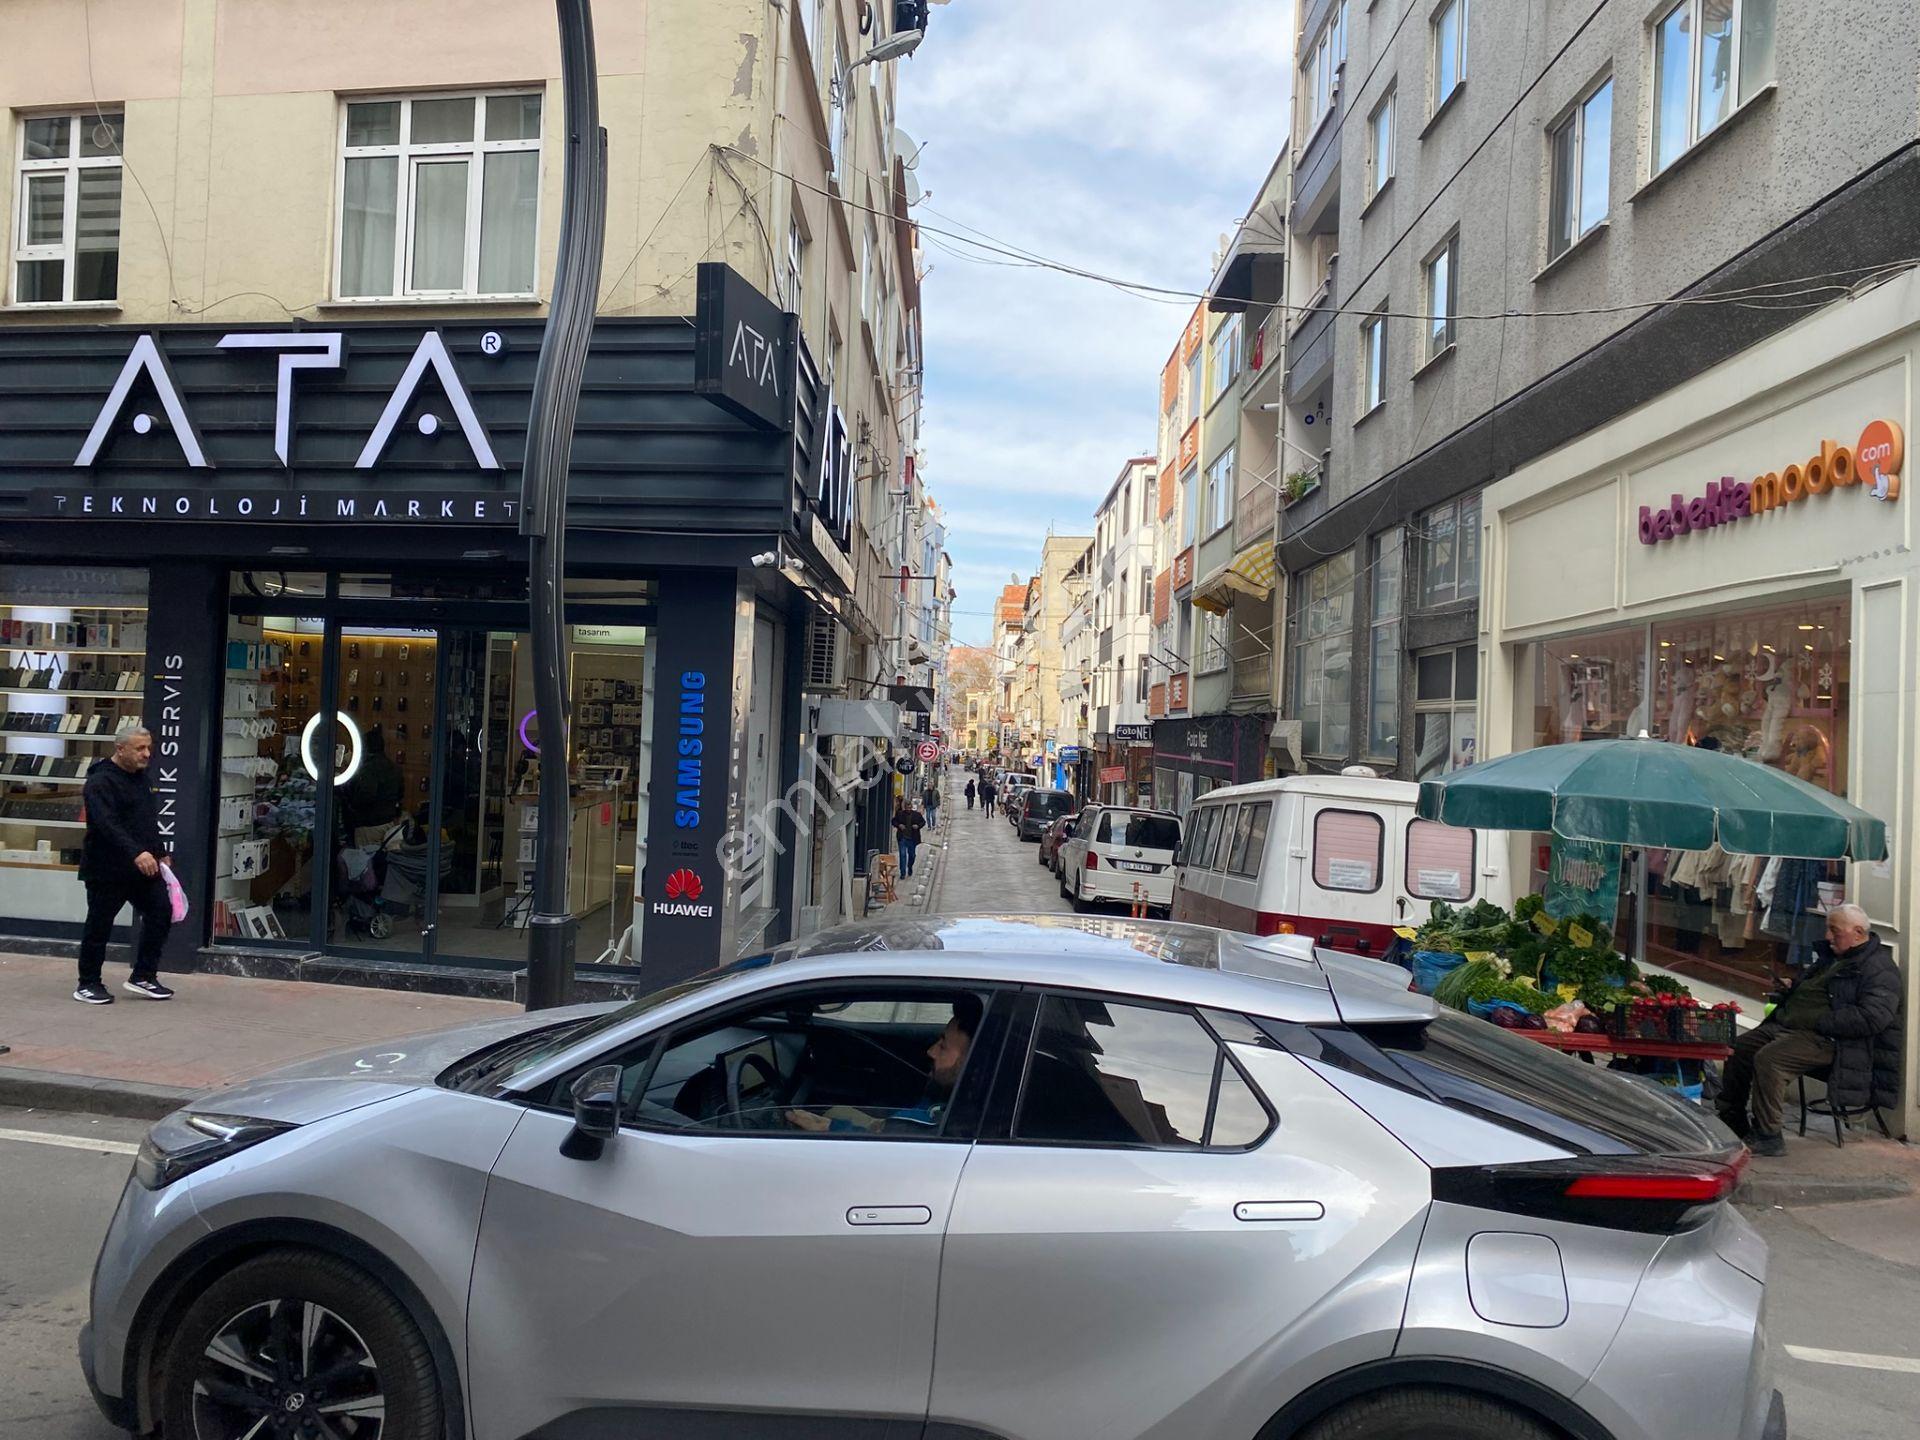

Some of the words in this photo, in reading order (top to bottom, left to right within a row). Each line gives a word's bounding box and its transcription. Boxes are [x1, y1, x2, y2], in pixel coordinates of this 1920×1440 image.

[728, 319, 779, 397] ATA
[73, 332, 503, 468] ATA
[54, 493, 308, 517] TEKNOLOJİ
[337, 499, 519, 519] MARKET
[578, 628, 610, 637] tasarım
[154, 655, 183, 757] SERVİS
[675, 671, 707, 829] SAMSUNG
[150, 766, 179, 853] EKNİK
[653, 902, 713, 918] HUAWEI
